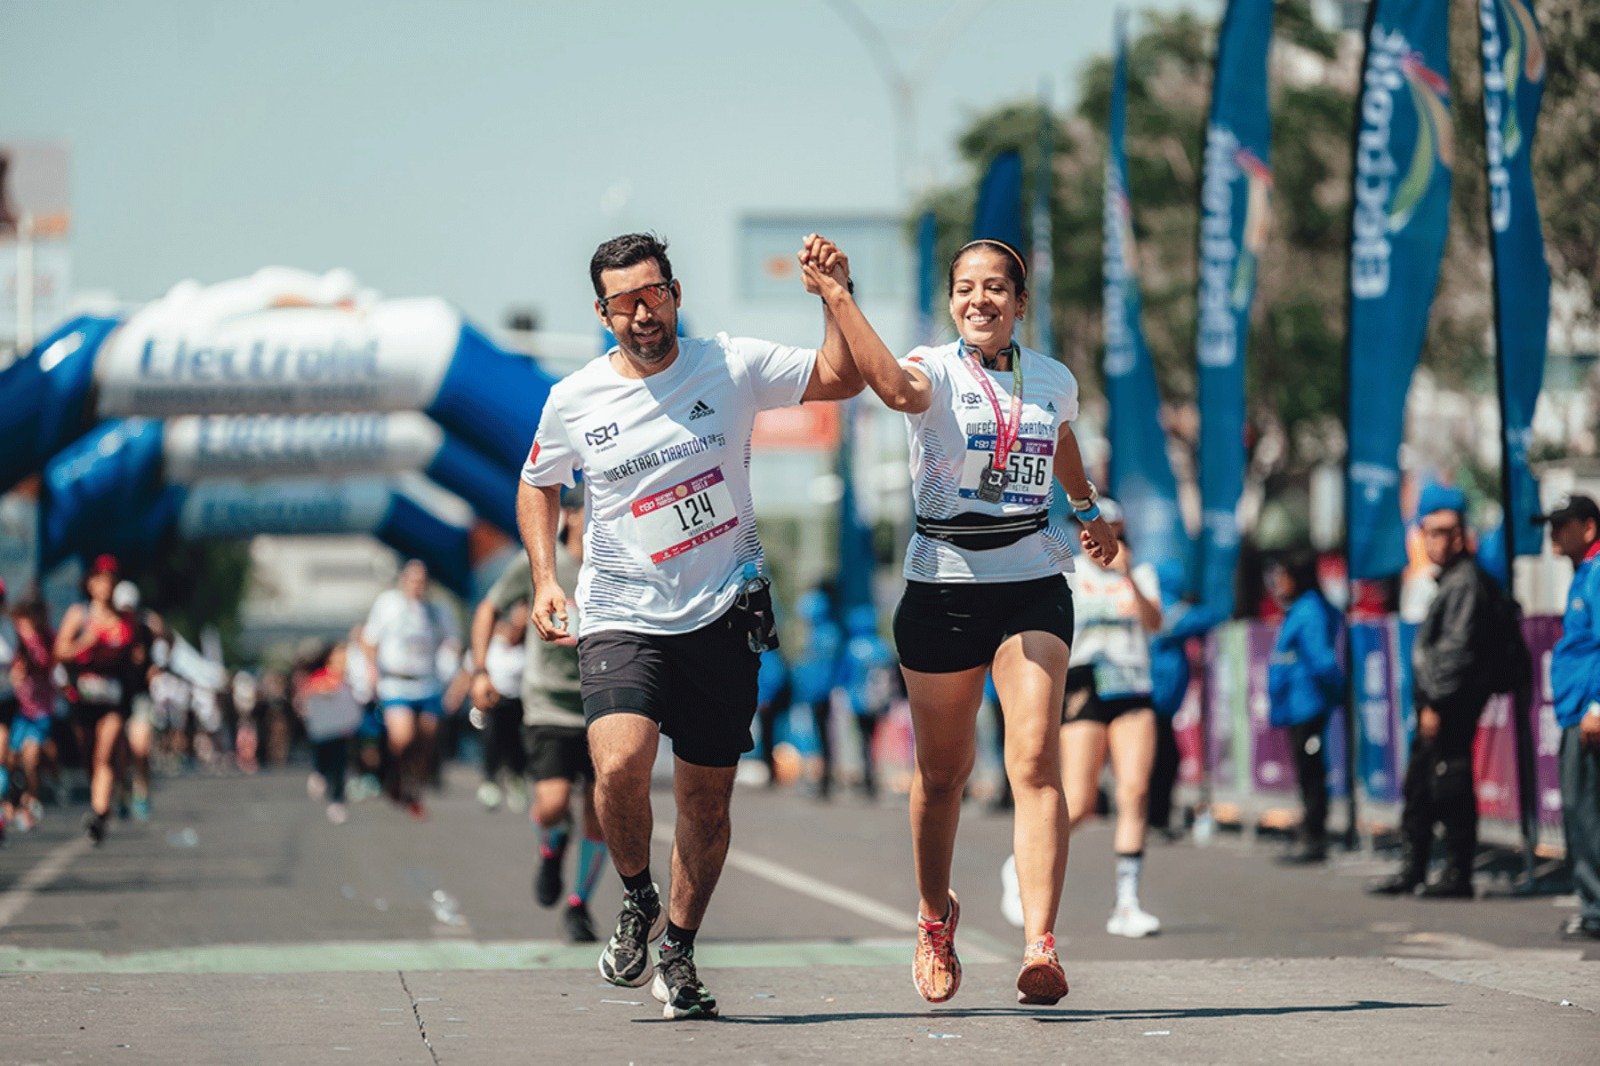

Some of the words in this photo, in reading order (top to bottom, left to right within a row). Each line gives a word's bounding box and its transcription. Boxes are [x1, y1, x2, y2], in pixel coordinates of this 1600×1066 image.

[689, 409, 715, 421] adidas
[604, 452, 660, 483] QUERÉTARO
[660, 436, 709, 464] MARATÓN
[988, 453, 1047, 486] 1556
[673, 491, 716, 532] 124
